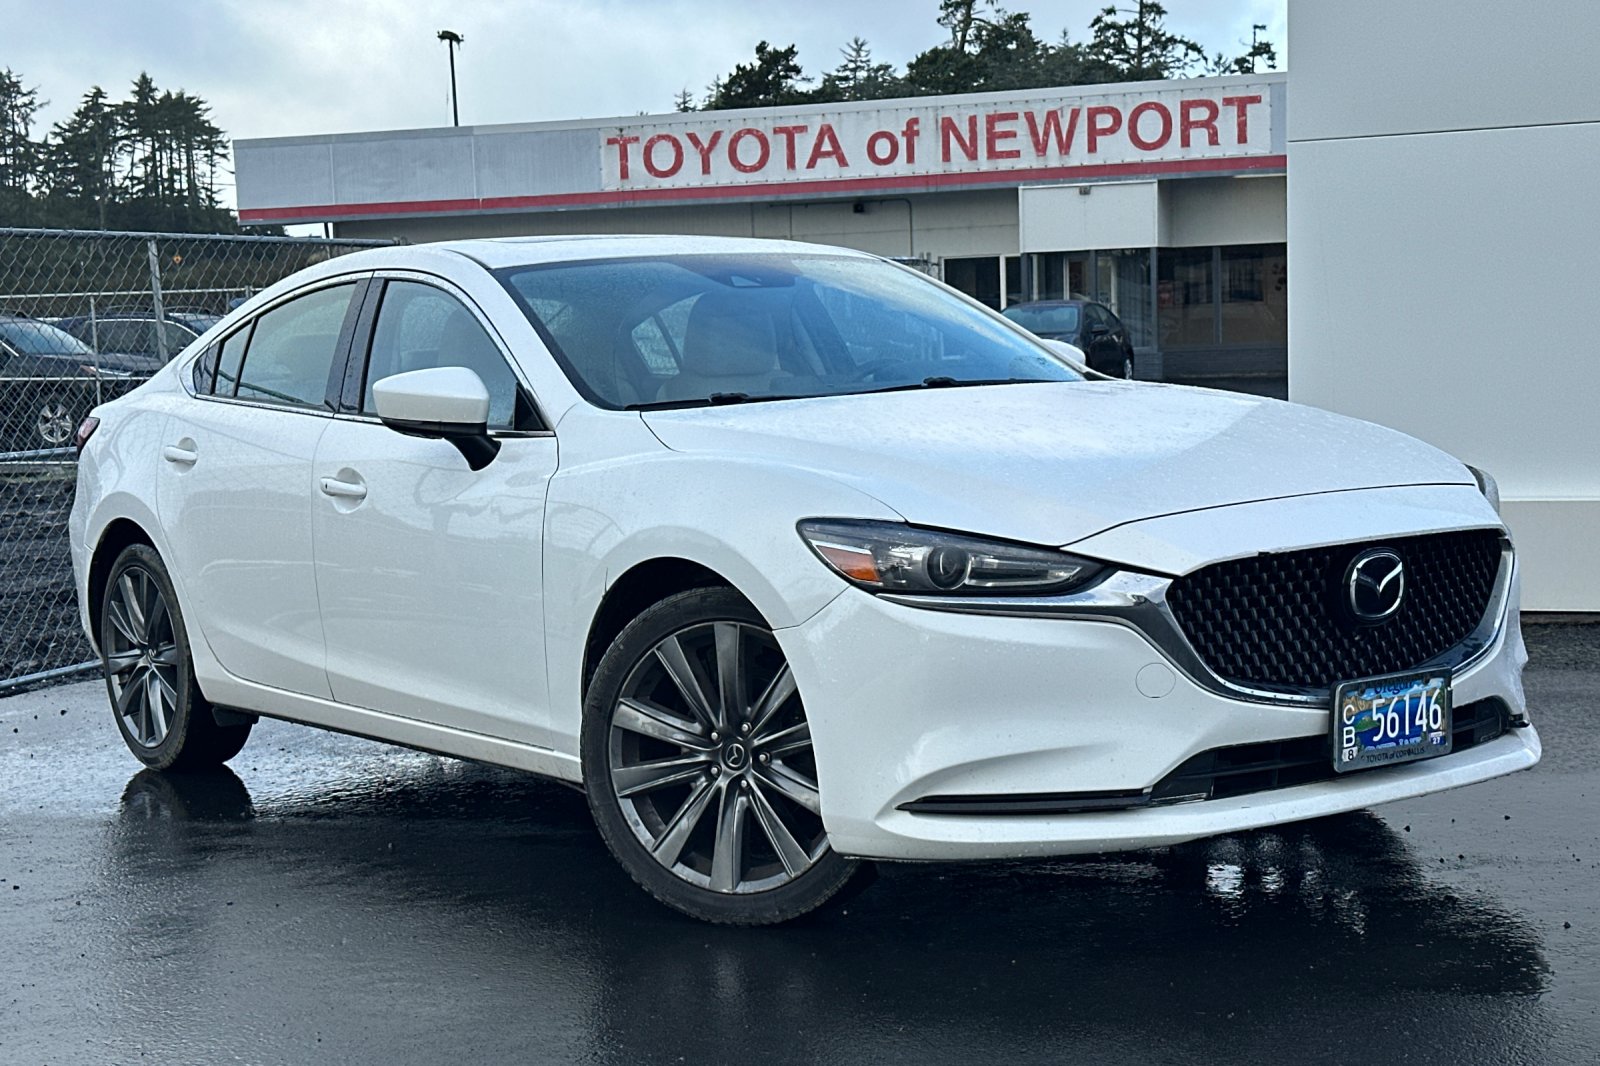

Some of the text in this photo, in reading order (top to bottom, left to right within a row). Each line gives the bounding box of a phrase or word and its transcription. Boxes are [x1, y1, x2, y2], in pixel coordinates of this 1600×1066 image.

[607, 95, 1262, 180] TOYOTA of NEWPORT
[1372, 688, 1442, 742] 56146
[1347, 748, 1354, 761] 8
